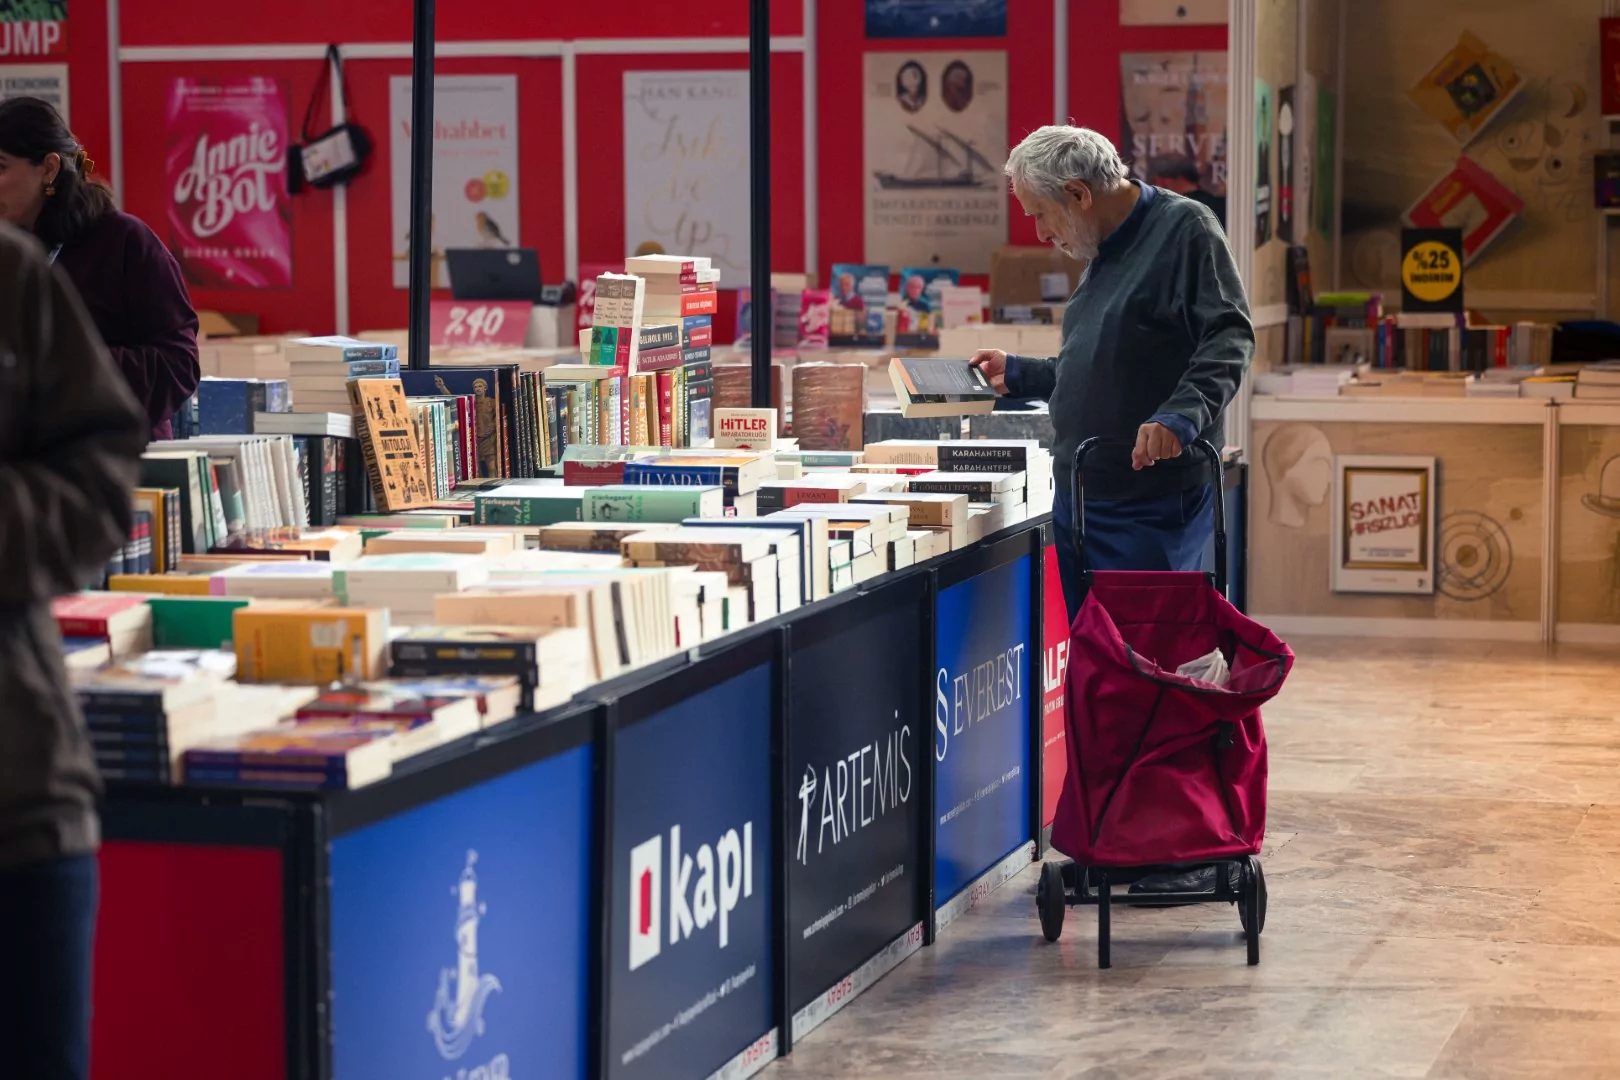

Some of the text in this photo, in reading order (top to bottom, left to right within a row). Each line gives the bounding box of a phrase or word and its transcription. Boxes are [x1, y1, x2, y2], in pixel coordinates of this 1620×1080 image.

[174, 122, 278, 204] Annie
[1132, 132, 1227, 158] SERVE
[192, 161, 287, 238] Bot
[1412, 250, 1450, 271] %25
[952, 449, 1012, 458] KARAHANTEPE
[953, 464, 1012, 472] KARAHANTEPE
[1350, 492, 1420, 520] SANAT
[1044, 638, 1070, 693] LF
[953, 642, 1024, 737] EVEREST
[670, 821, 753, 949] kapı
